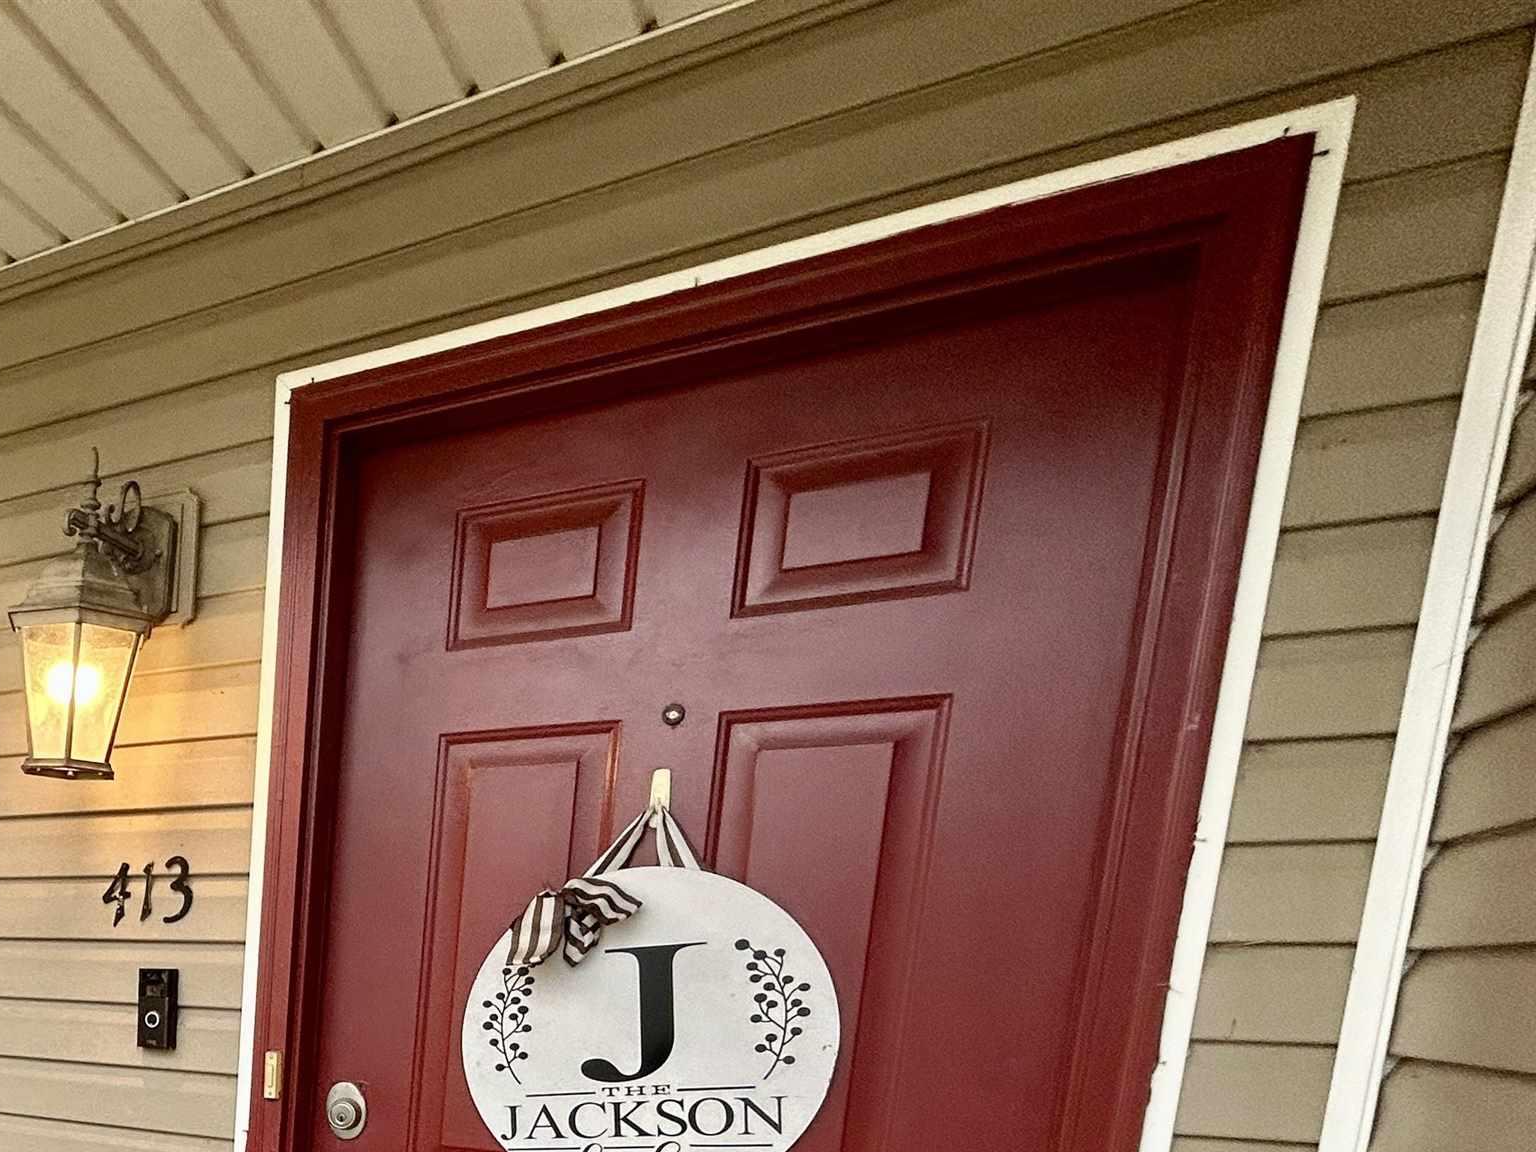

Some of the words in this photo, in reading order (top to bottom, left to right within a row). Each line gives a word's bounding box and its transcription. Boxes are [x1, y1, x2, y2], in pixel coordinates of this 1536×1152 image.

[102, 855, 194, 928] 413
[580, 941, 708, 1083] J
[501, 1096, 786, 1141] JACKSON
[602, 1084, 672, 1097] THE
